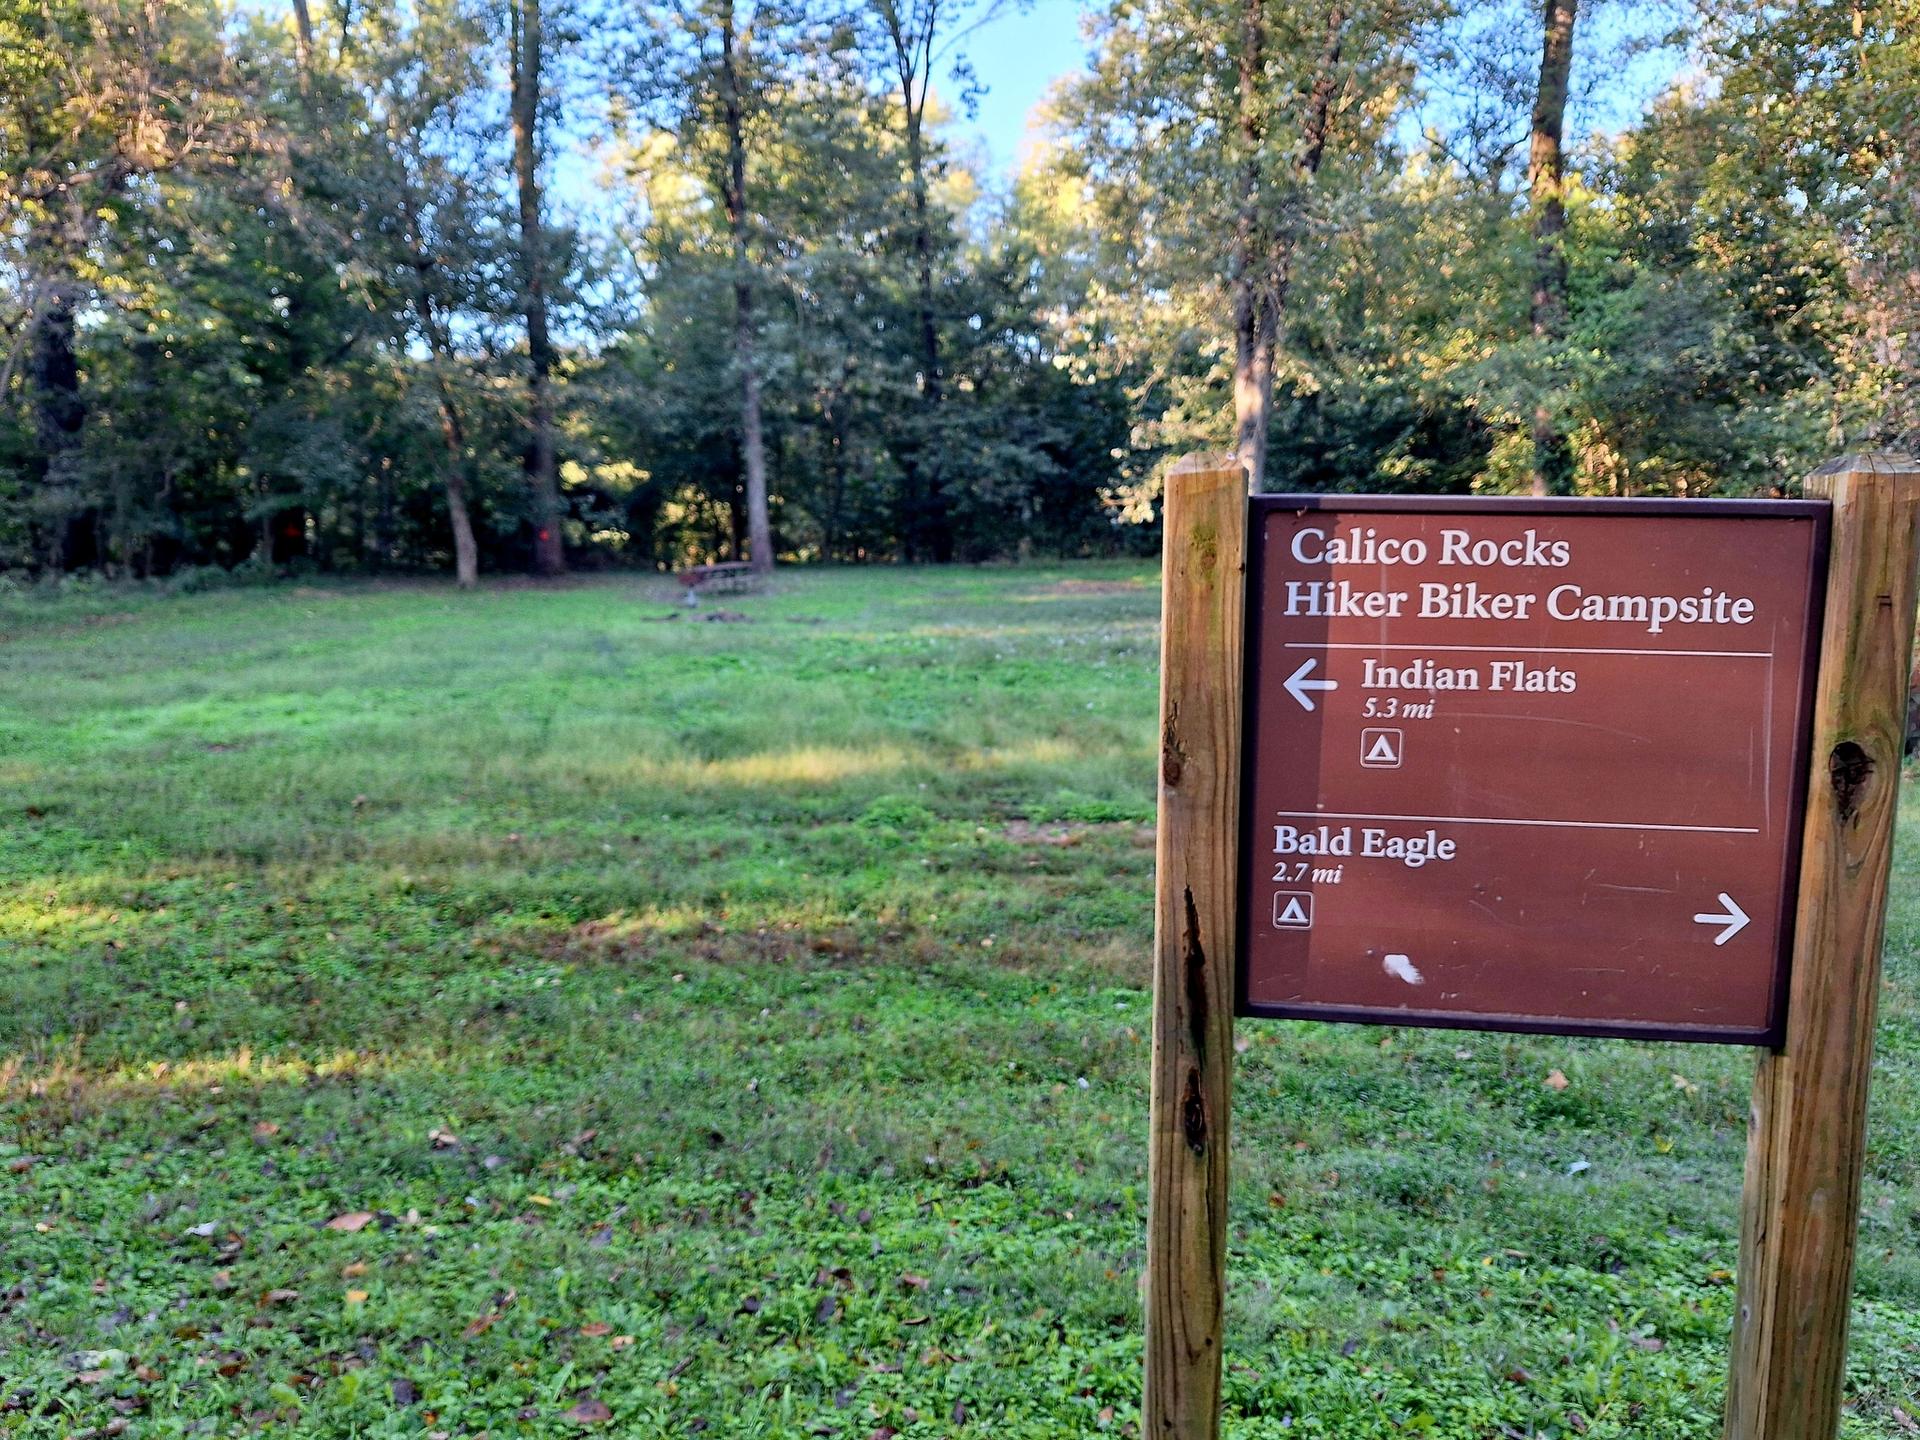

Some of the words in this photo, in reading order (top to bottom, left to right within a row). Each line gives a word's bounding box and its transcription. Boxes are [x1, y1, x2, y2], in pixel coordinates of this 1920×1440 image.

[1292, 528, 1427, 566] Calico
[1440, 530, 1571, 567] Rocks
[1284, 581, 1408, 618] Hiker
[1418, 583, 1536, 621] Biker
[1547, 585, 1755, 633] Campsite
[1361, 659, 1479, 692] Indian
[1489, 661, 1577, 693] Flats
[1362, 698, 1398, 719] 5.3
[1402, 698, 1434, 720] mi
[1273, 826, 1352, 856] Bald
[1361, 829, 1456, 867] Eagle
[1272, 862, 1308, 883] 2.7
[1312, 864, 1343, 885] mi
